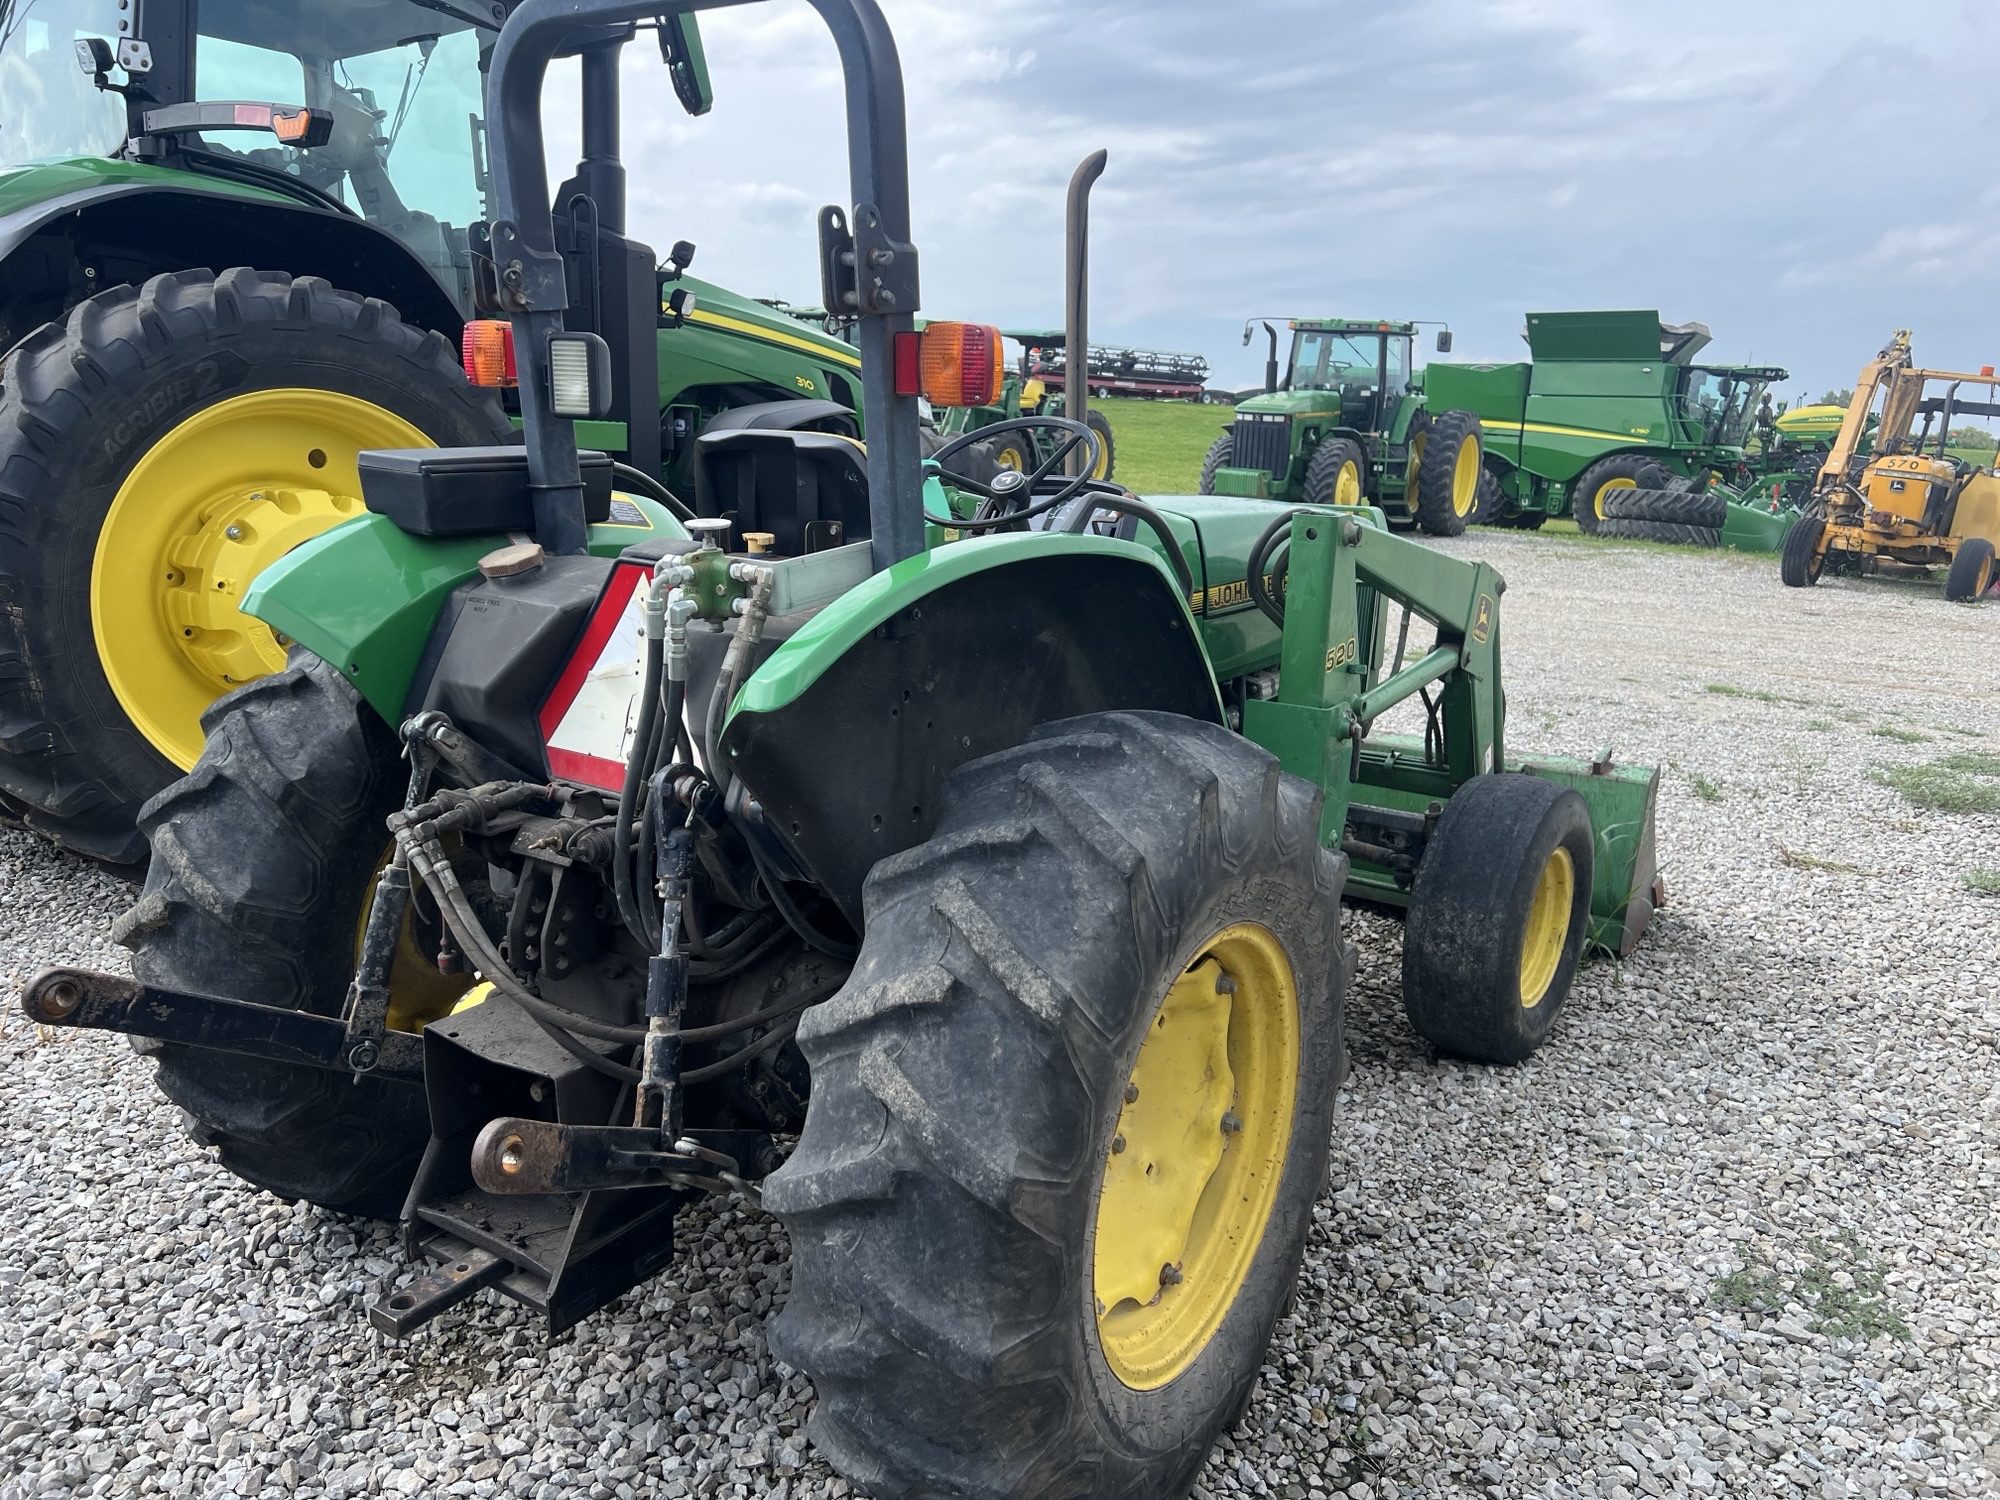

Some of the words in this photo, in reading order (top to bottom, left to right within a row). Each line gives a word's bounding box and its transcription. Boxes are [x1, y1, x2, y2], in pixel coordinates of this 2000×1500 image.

[795, 376, 815, 391] 310
[1887, 459, 1919, 470] 570
[1325, 637, 1356, 673] 520
